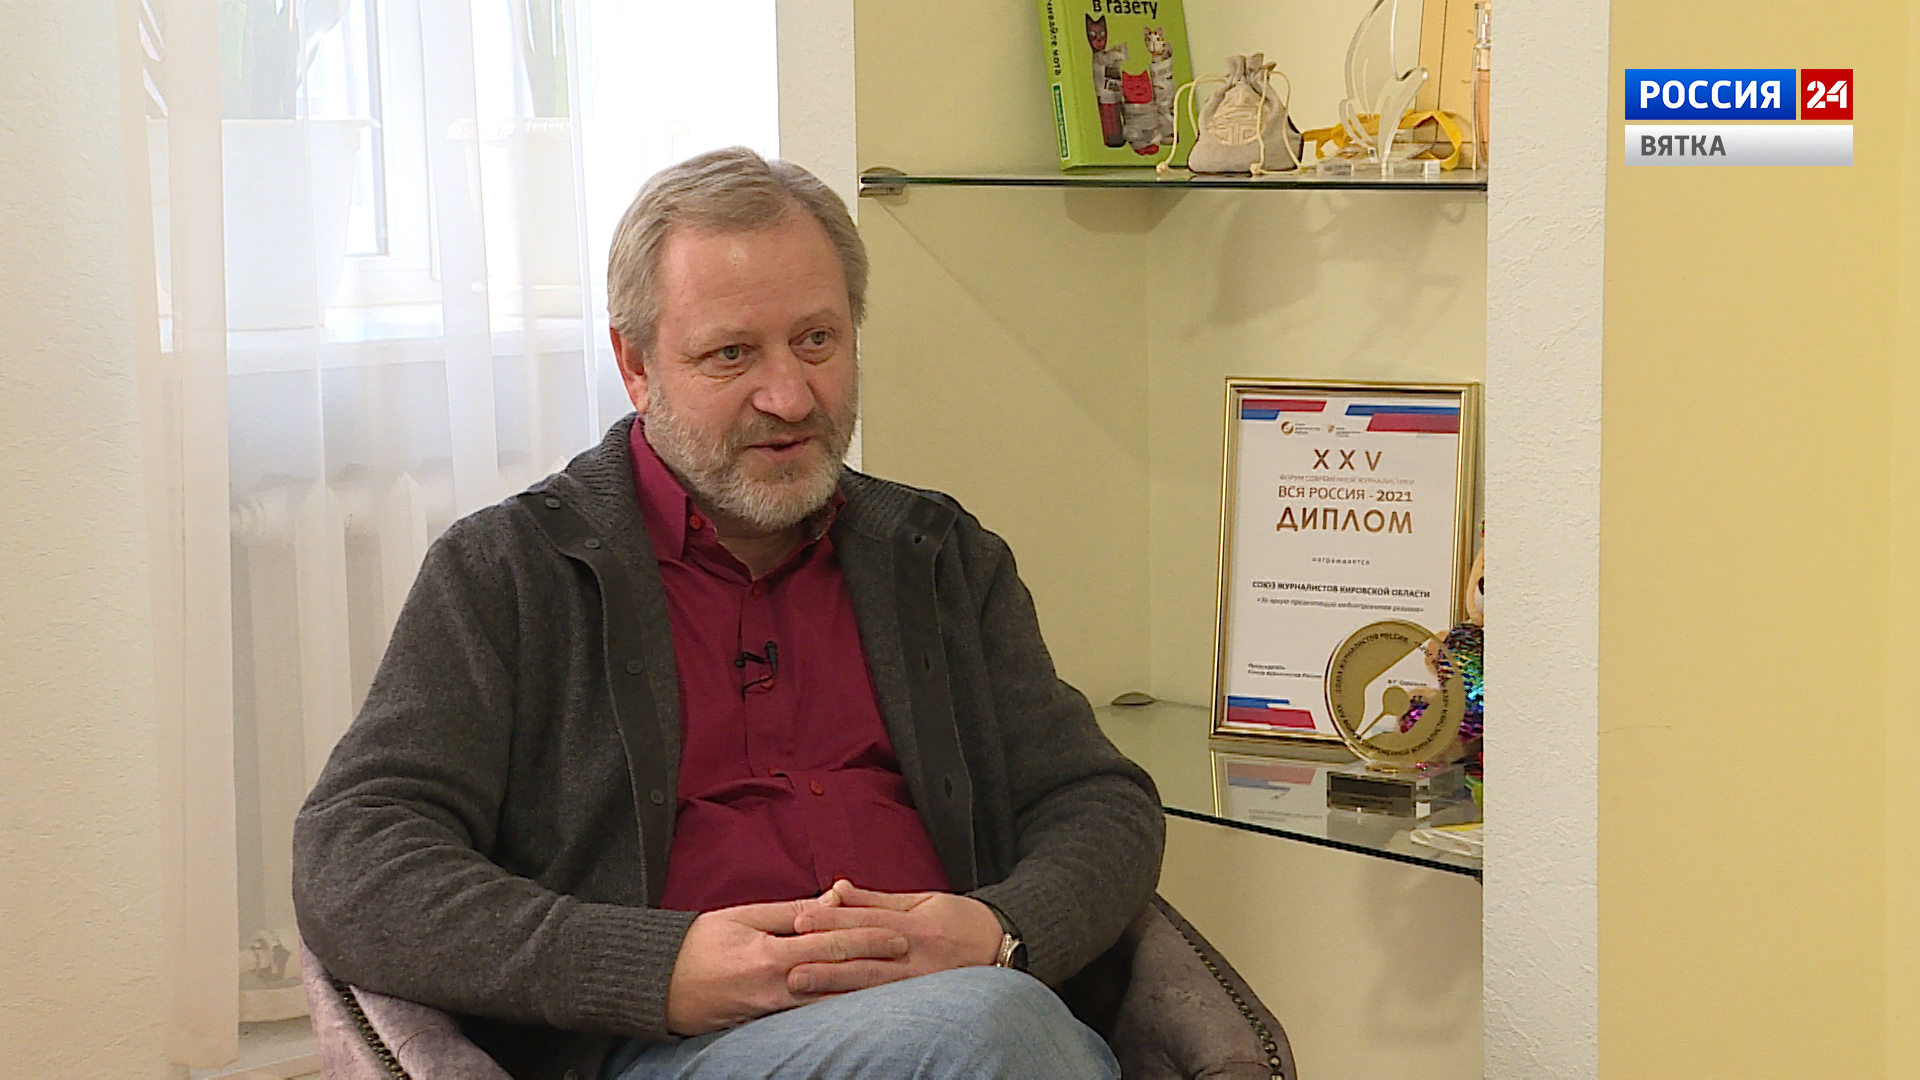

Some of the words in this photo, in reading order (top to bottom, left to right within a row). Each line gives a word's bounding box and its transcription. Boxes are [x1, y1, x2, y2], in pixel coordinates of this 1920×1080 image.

[1106, 0, 1158, 20] газету
[1278, 485, 1305, 498] ВСЯ
[1309, 486, 1365, 500] РОССИЯ
[1376, 489, 1413, 502] 2021
[1276, 507, 1413, 534] ДИПЛОМ
[1252, 581, 1276, 589] СОЮЗ
[1277, 582, 1338, 593] ЖУРНАЛИСТОВ
[1340, 585, 1390, 596] КИРОВСКОЙ
[1391, 588, 1430, 598] ОБЛАСТИ
